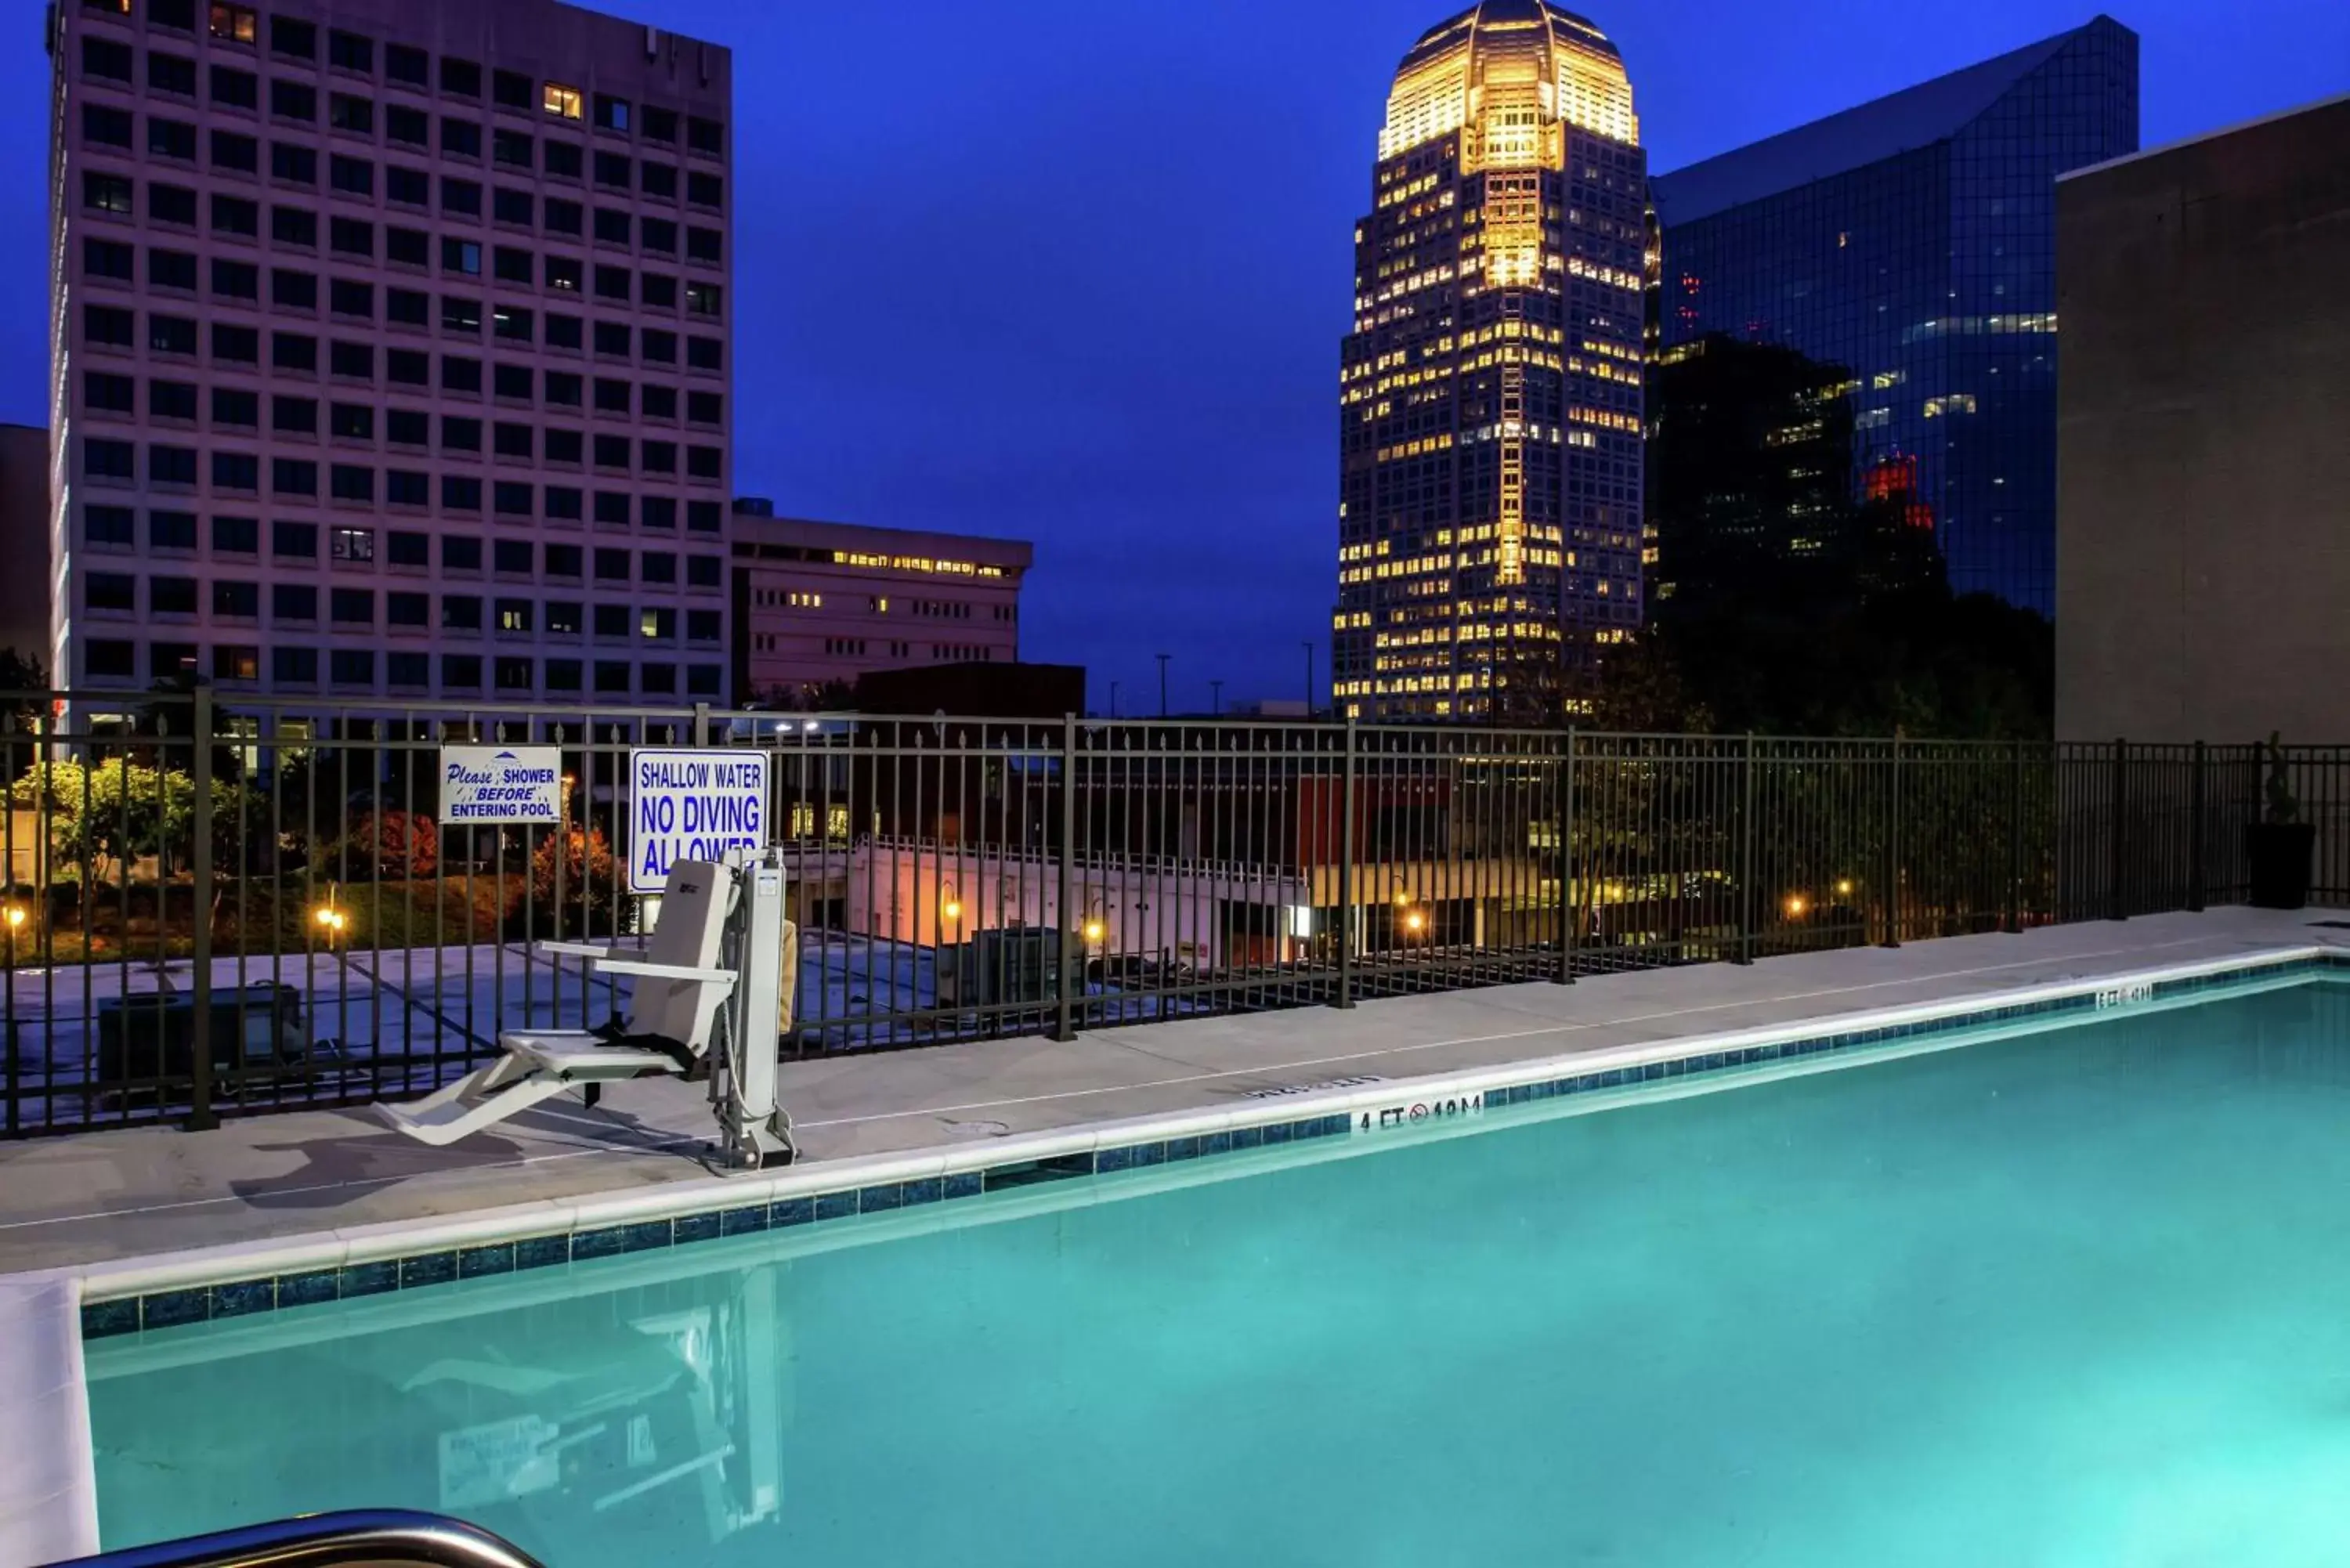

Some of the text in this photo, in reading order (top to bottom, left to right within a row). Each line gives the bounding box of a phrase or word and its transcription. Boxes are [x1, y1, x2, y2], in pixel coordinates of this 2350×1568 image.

[447, 764, 555, 784] Please SHOWER
[641, 762, 761, 789] SHALLOW WATER
[476, 787, 537, 801] BEFORE
[451, 803, 554, 817] ENTERING POOL
[642, 795, 759, 834] NO DIVING
[642, 837, 756, 876] ALLOWD
